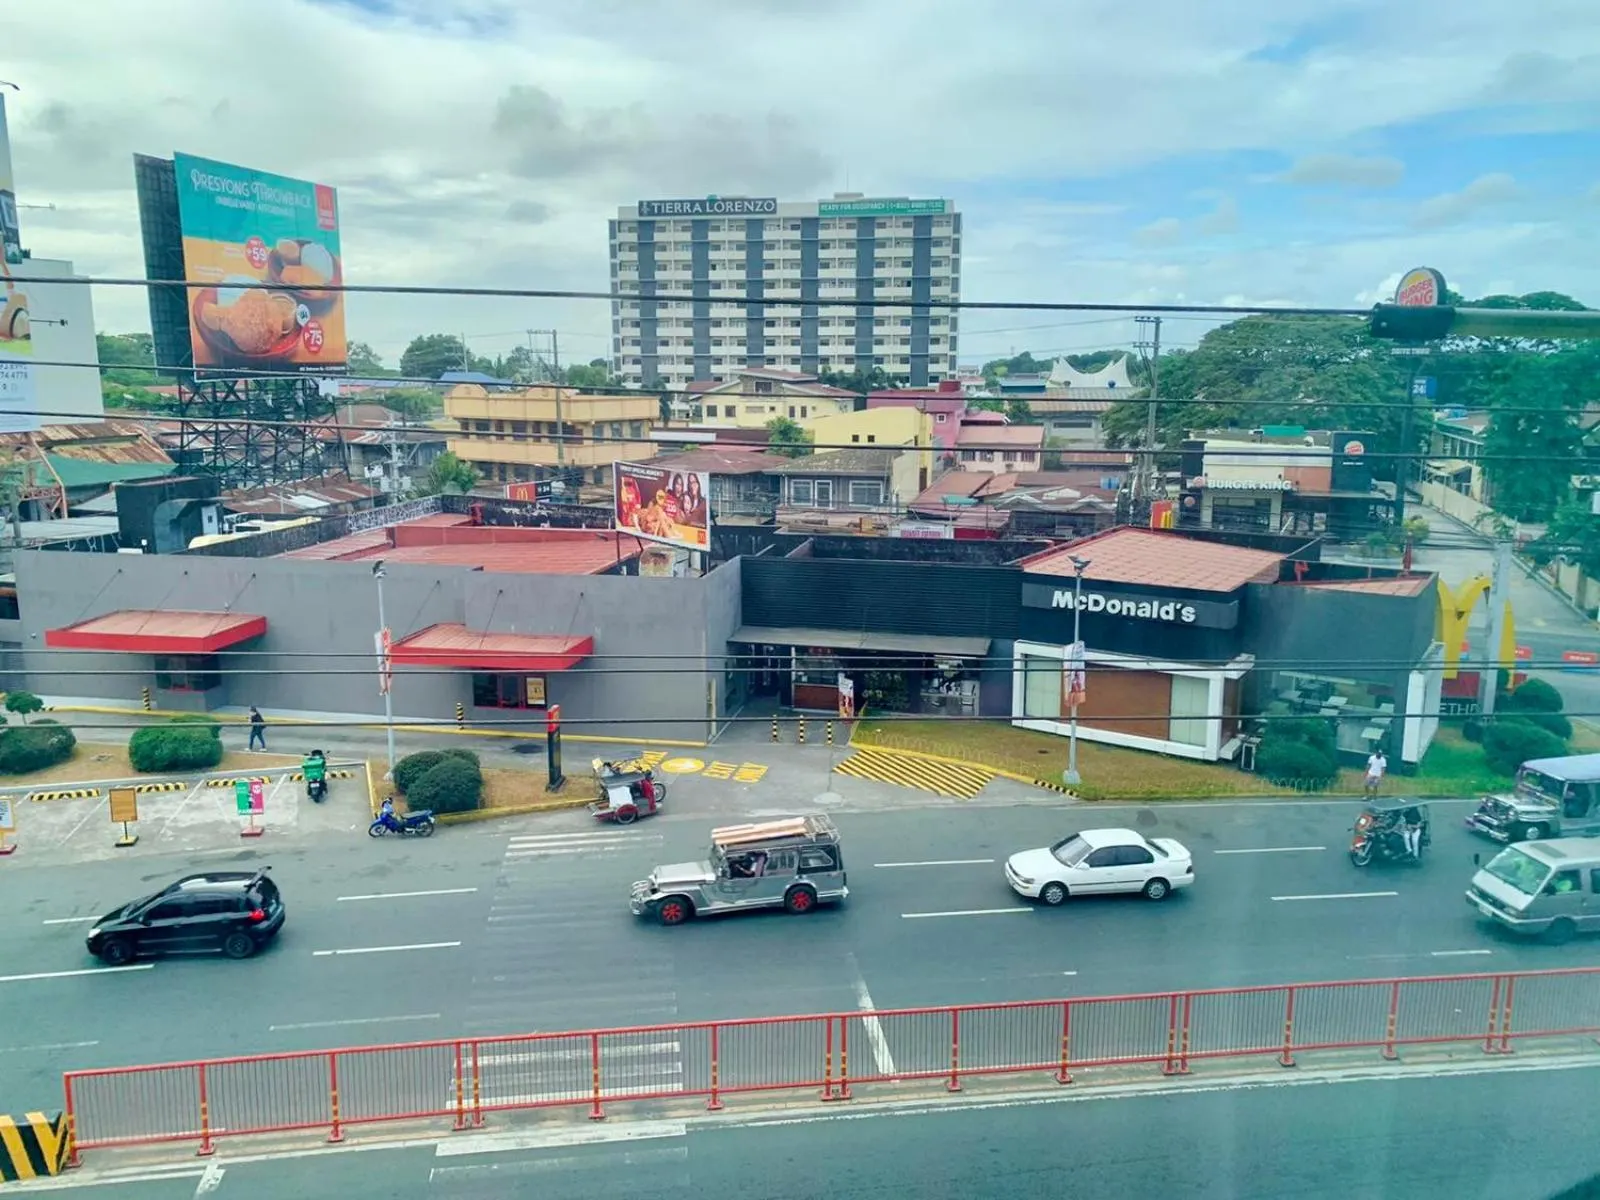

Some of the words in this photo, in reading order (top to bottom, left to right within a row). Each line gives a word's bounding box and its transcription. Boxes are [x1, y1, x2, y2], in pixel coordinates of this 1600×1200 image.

[191, 169, 250, 195] PRESYONG
[651, 201, 703, 214] TIERRA
[706, 199, 776, 213] LORENZO
[1399, 278, 1433, 302] BURGER
[1207, 479, 1256, 489] BURGER
[1260, 479, 1292, 490] KING
[1051, 590, 1196, 623] McDonald's
